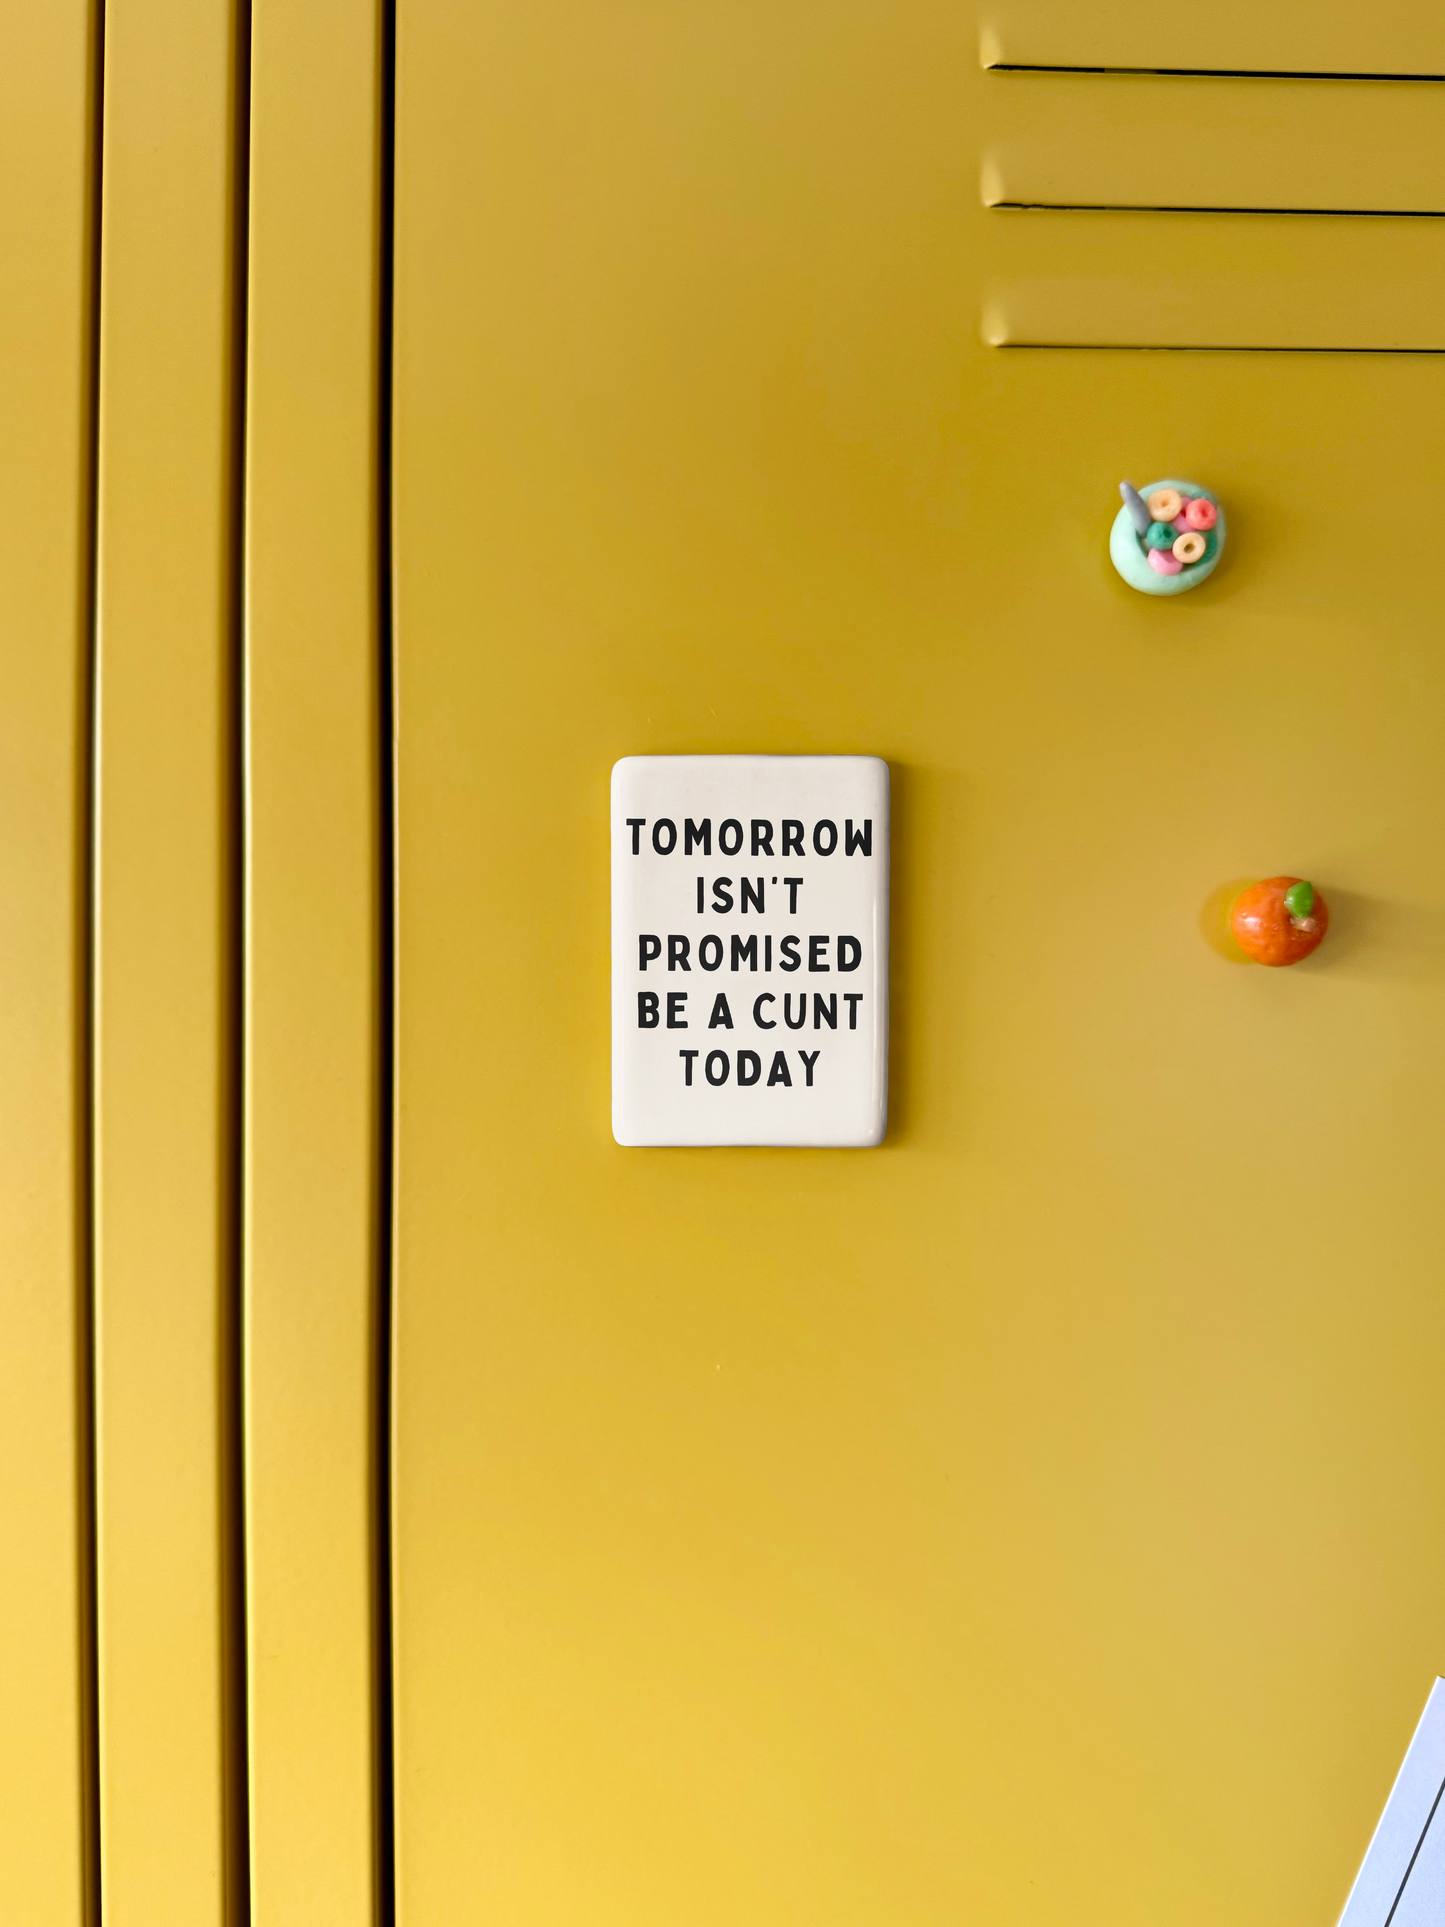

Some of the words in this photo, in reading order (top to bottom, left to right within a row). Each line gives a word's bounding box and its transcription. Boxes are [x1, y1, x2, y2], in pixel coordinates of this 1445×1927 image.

[627, 818, 872, 856] TOMORROW
[697, 877, 803, 914] ISN'T
[639, 935, 861, 972] PROMISED
[638, 992, 688, 1029] BE
[708, 992, 734, 1029] A
[753, 992, 863, 1029] CUNT
[680, 1050, 820, 1087] TODAY
